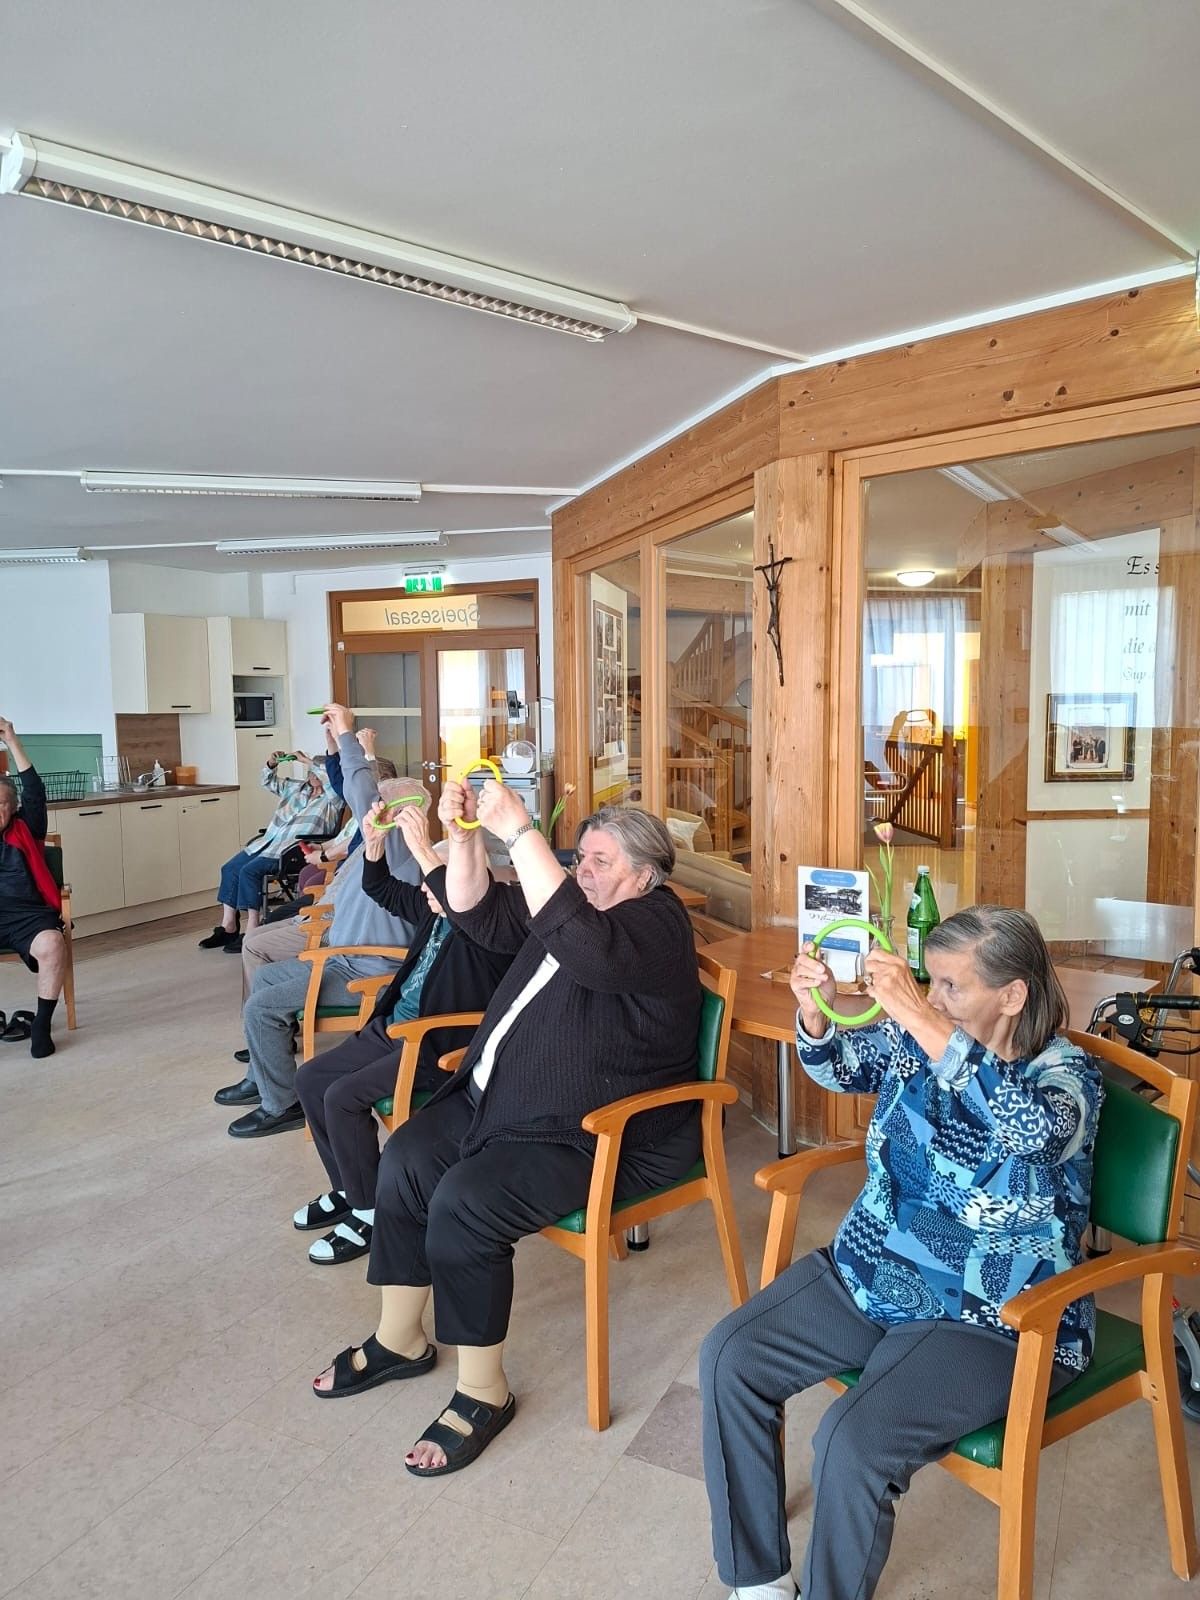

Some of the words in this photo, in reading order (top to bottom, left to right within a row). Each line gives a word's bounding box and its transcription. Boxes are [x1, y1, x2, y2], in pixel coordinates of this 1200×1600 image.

[1127, 555, 1150, 575] Es
[1125, 599, 1151, 616] mit
[1123, 636, 1145, 654] die
